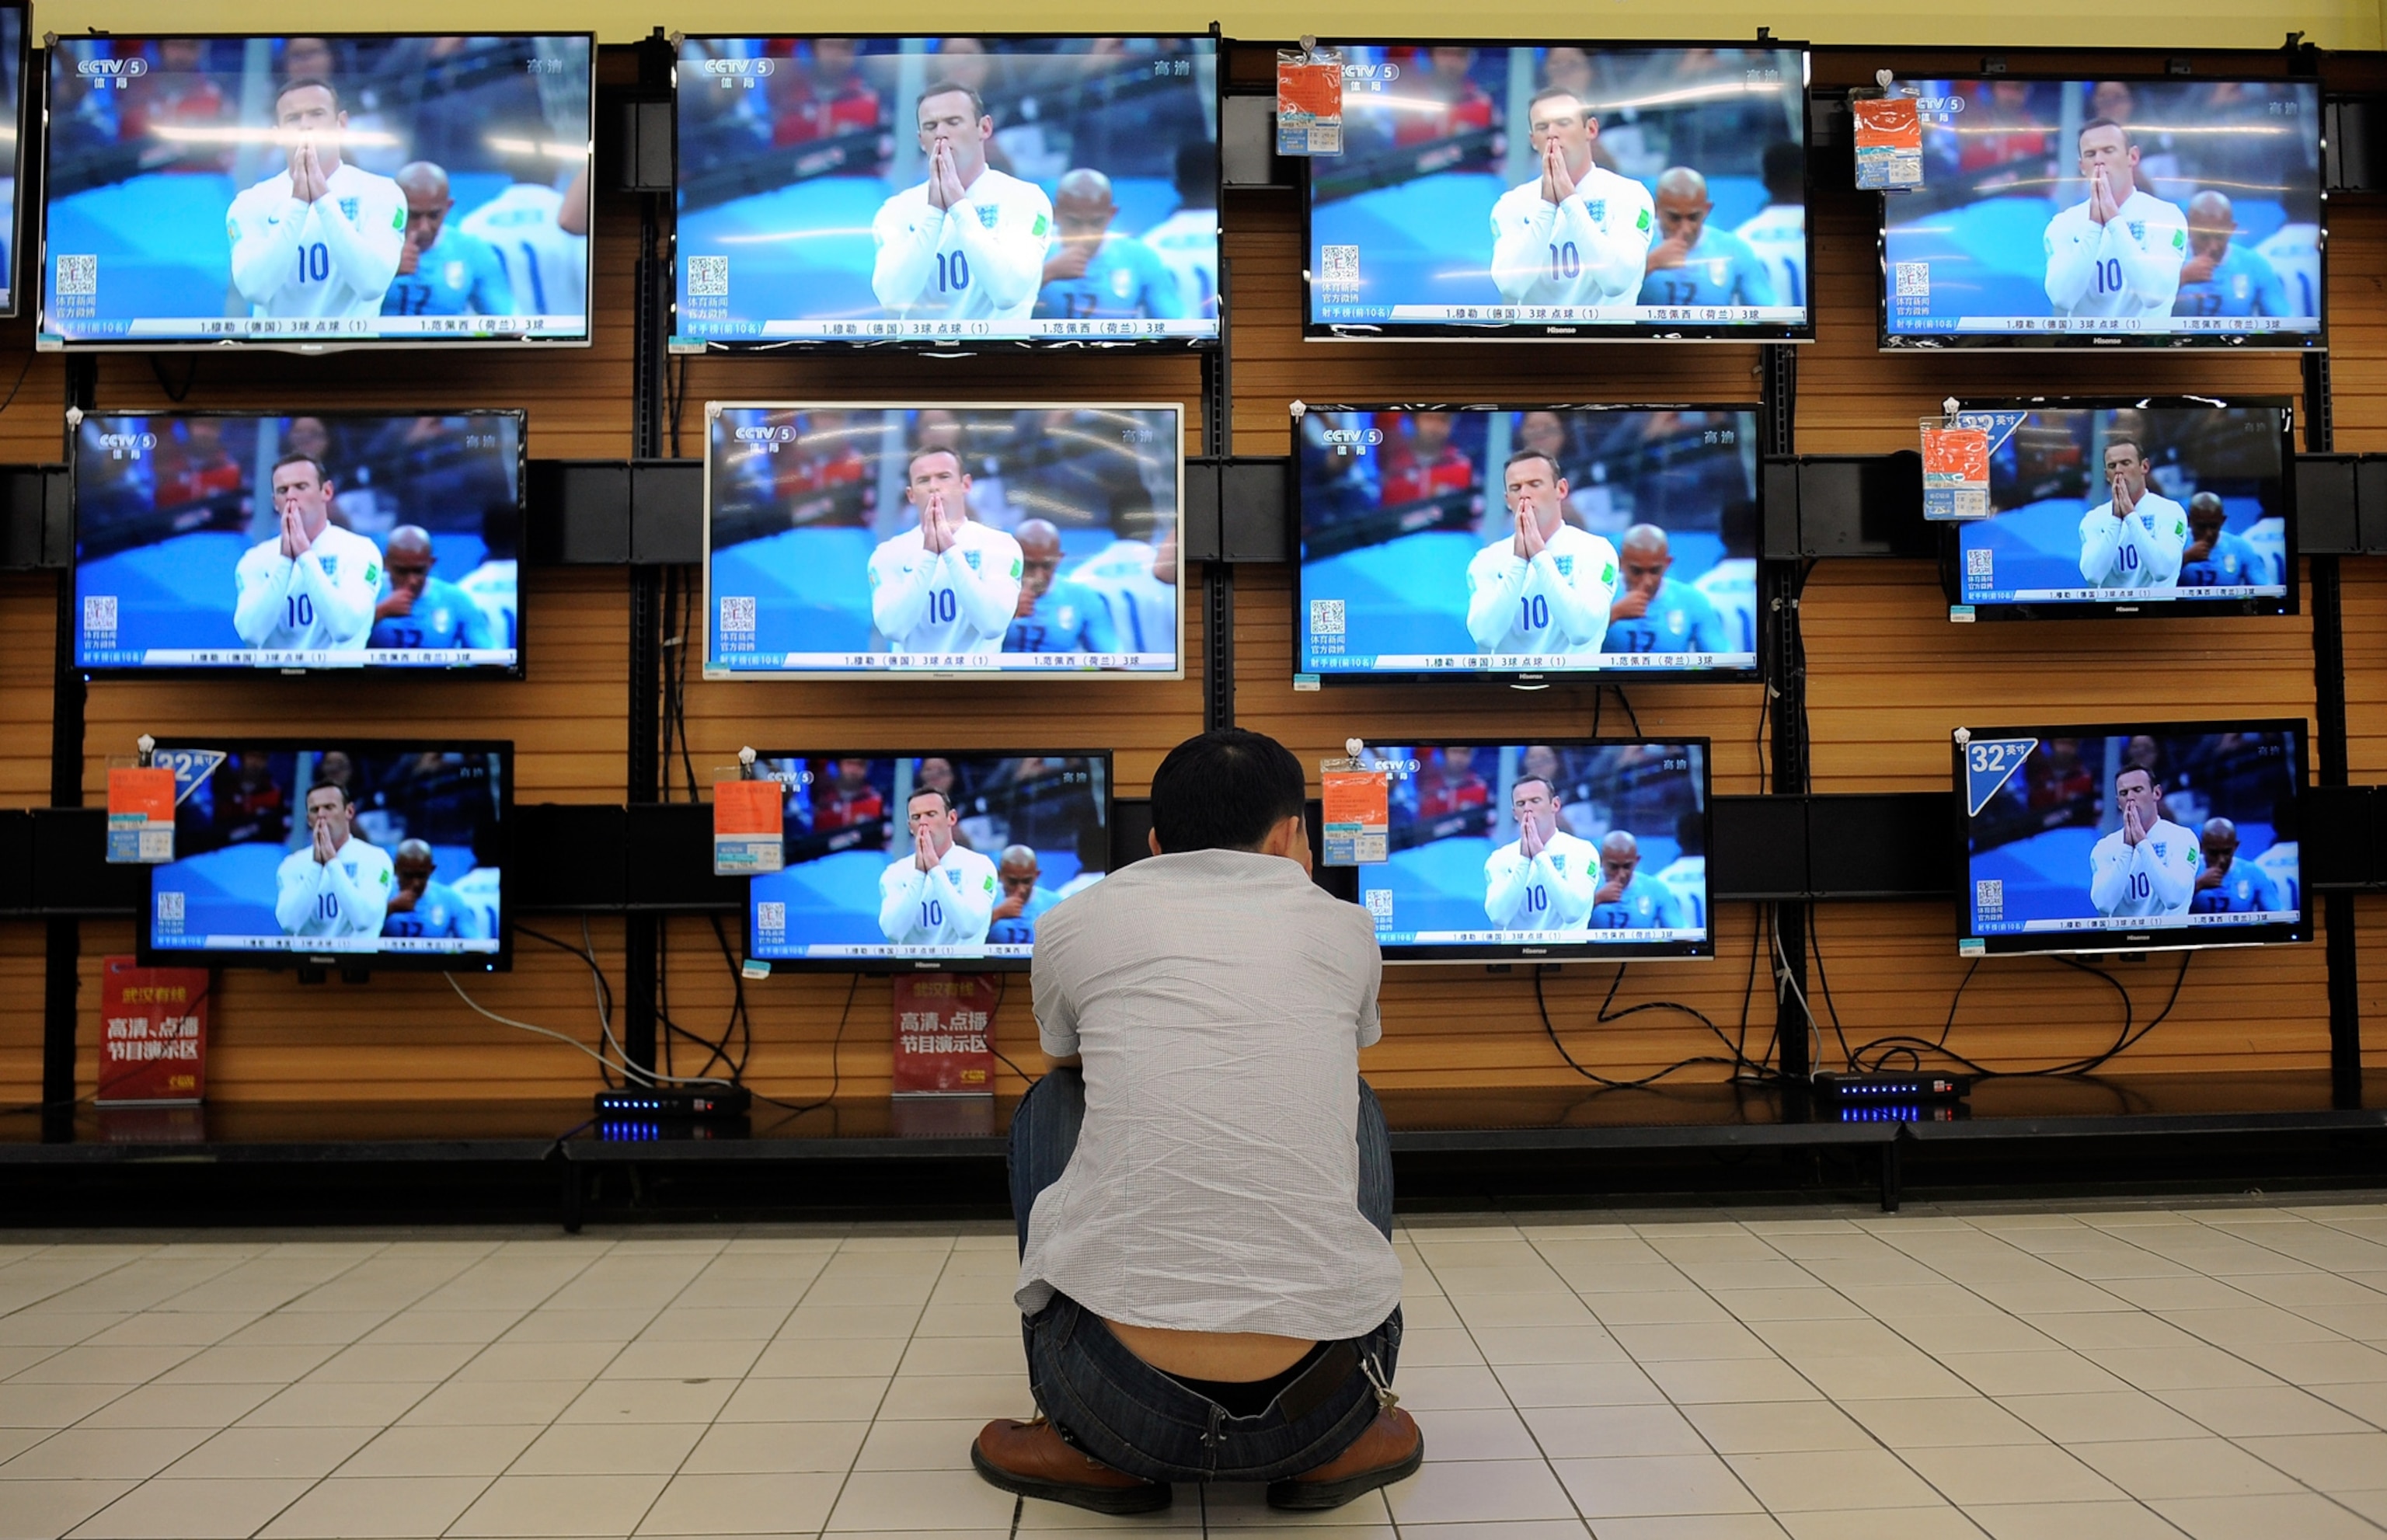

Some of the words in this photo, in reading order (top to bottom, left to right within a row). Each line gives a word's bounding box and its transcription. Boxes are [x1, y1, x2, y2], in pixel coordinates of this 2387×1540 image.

[78, 60, 122, 75] CCTV
[704, 59, 749, 74] CCTV
[1155, 60, 1190, 75] 高清
[298, 242, 329, 283] 10
[936, 250, 969, 292] 10
[1549, 242, 1580, 280] 10
[2097, 259, 2124, 294] 10
[1996, 415, 2016, 425] 英寸
[99, 435, 136, 447] CCTV
[736, 427, 774, 440] CCTV
[1322, 430, 1361, 442] CCTV
[1705, 430, 1734, 444] 高清
[2117, 544, 2137, 570] 10
[287, 593, 312, 627] 10
[929, 588, 956, 623] 10
[1521, 594, 1549, 630] 10
[1375, 761, 1403, 770] CCTV
[1971, 744, 2005, 772] 32
[2006, 744, 2026, 755] 英寸
[768, 772, 797, 782] CCTV
[2128, 872, 2148, 899] 10
[317, 891, 338, 919] 10
[1526, 885, 1547, 912] 10
[921, 899, 942, 927] 10
[107, 1016, 199, 1040] 高清、点播
[900, 1012, 988, 1032] 高清、点播
[107, 1039, 199, 1061] 节目演示区
[900, 1034, 988, 1054] 节目演示区
